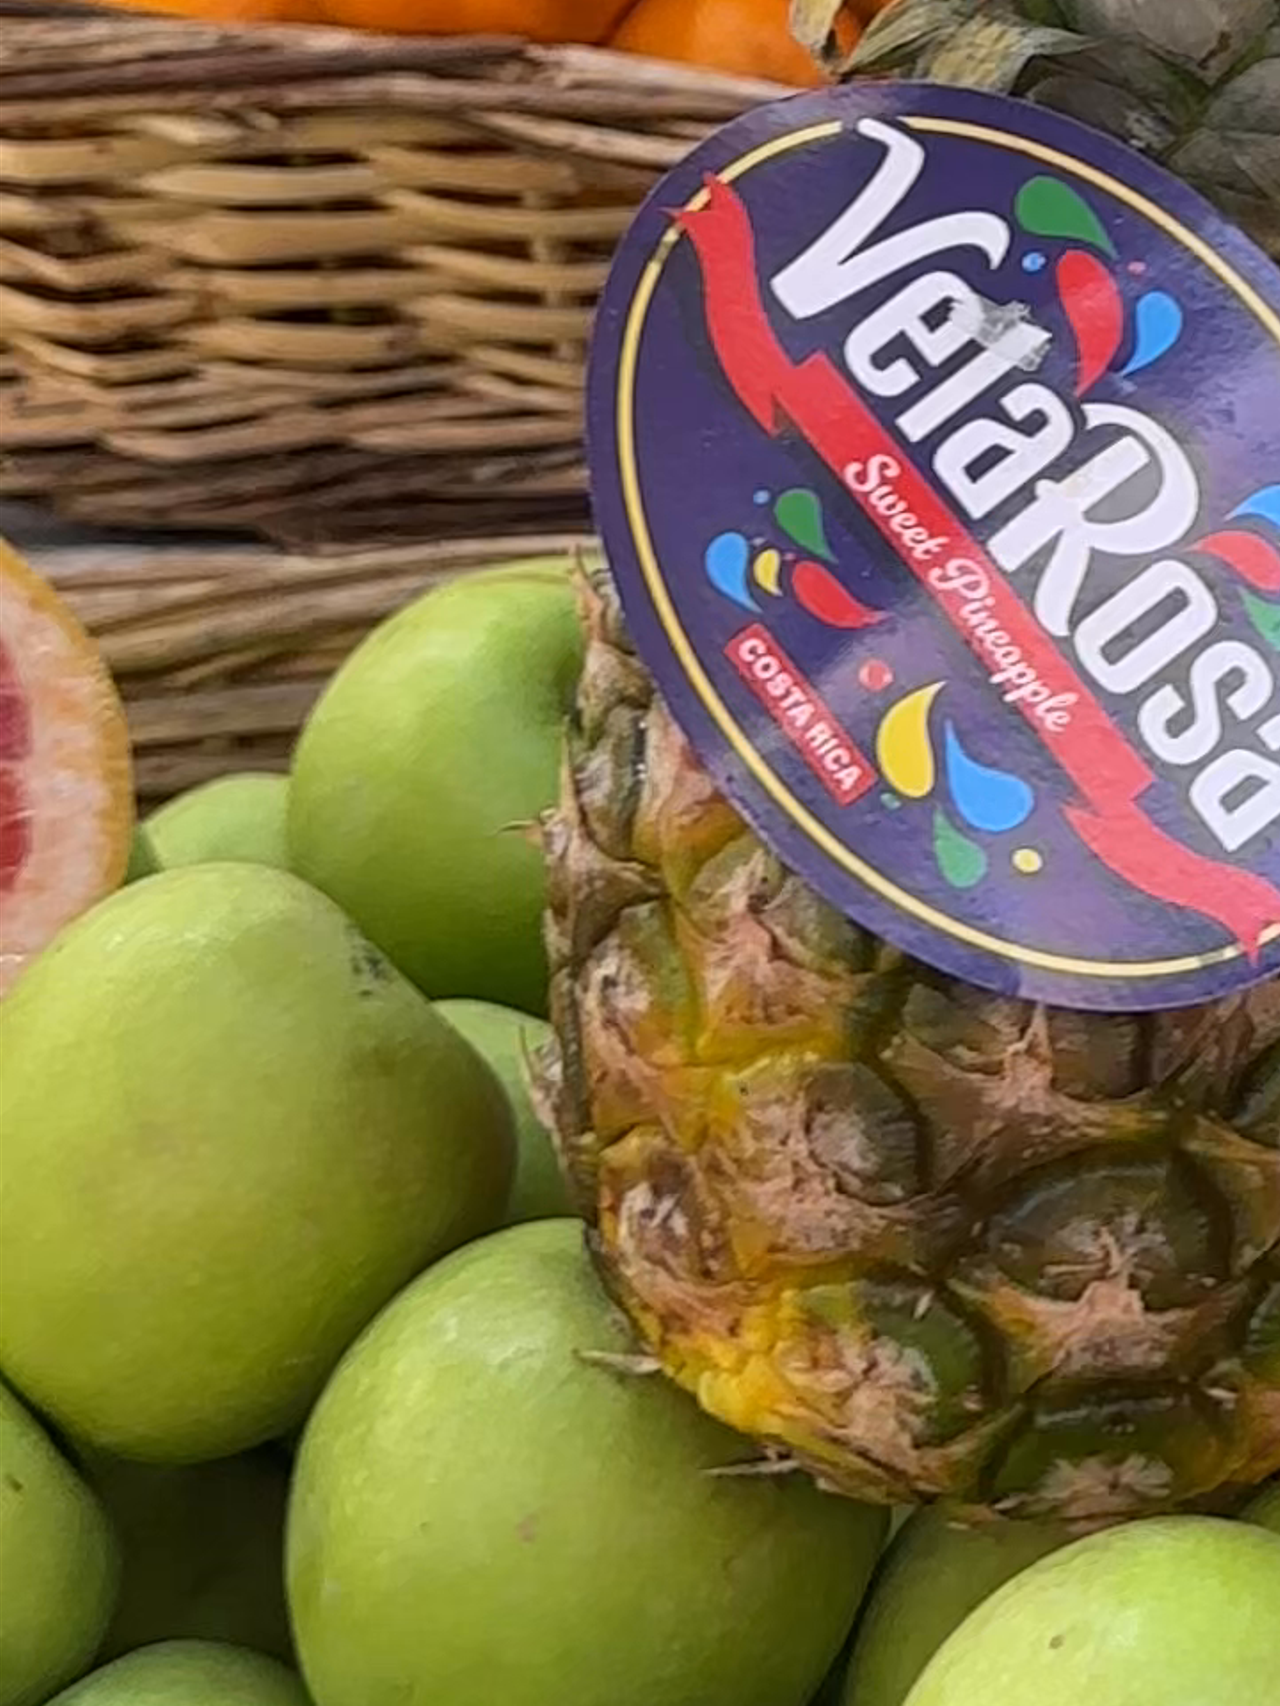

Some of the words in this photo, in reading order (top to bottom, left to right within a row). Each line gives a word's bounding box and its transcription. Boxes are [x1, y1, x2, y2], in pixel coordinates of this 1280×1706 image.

[844, 454, 950, 560] Sweet
[929, 557, 1081, 732] Pineapple
[738, 638, 816, 727] COSTA
[804, 721, 863, 791] RICA
